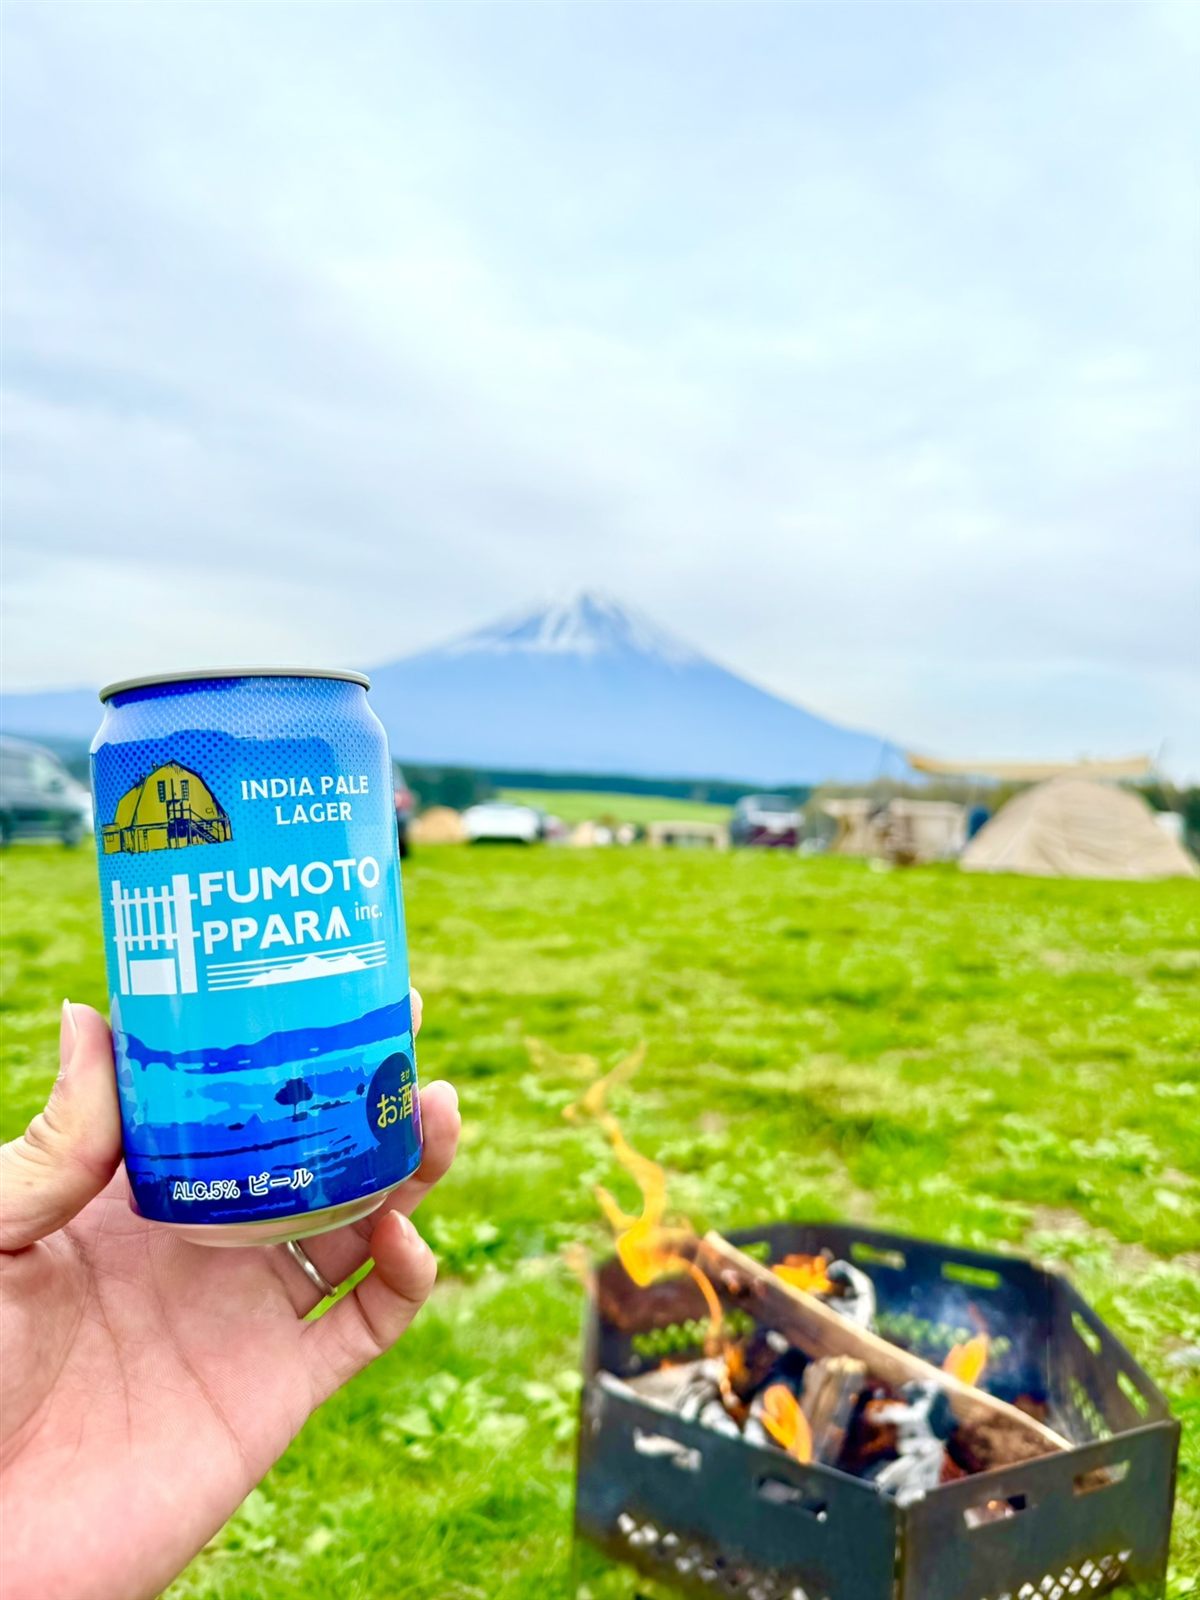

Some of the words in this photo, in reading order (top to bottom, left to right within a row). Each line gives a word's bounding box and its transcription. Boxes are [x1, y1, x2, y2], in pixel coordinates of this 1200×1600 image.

[241, 777, 313, 800] INDIA
[321, 775, 369, 795] PALE
[275, 802, 353, 825] LAGER
[199, 856, 380, 906] FUMOTO
[355, 901, 382, 921] inc.
[203, 906, 351, 954] PPARA
[173, 1181, 240, 1200] ALC.5%
[249, 1168, 313, 1196] ビール
